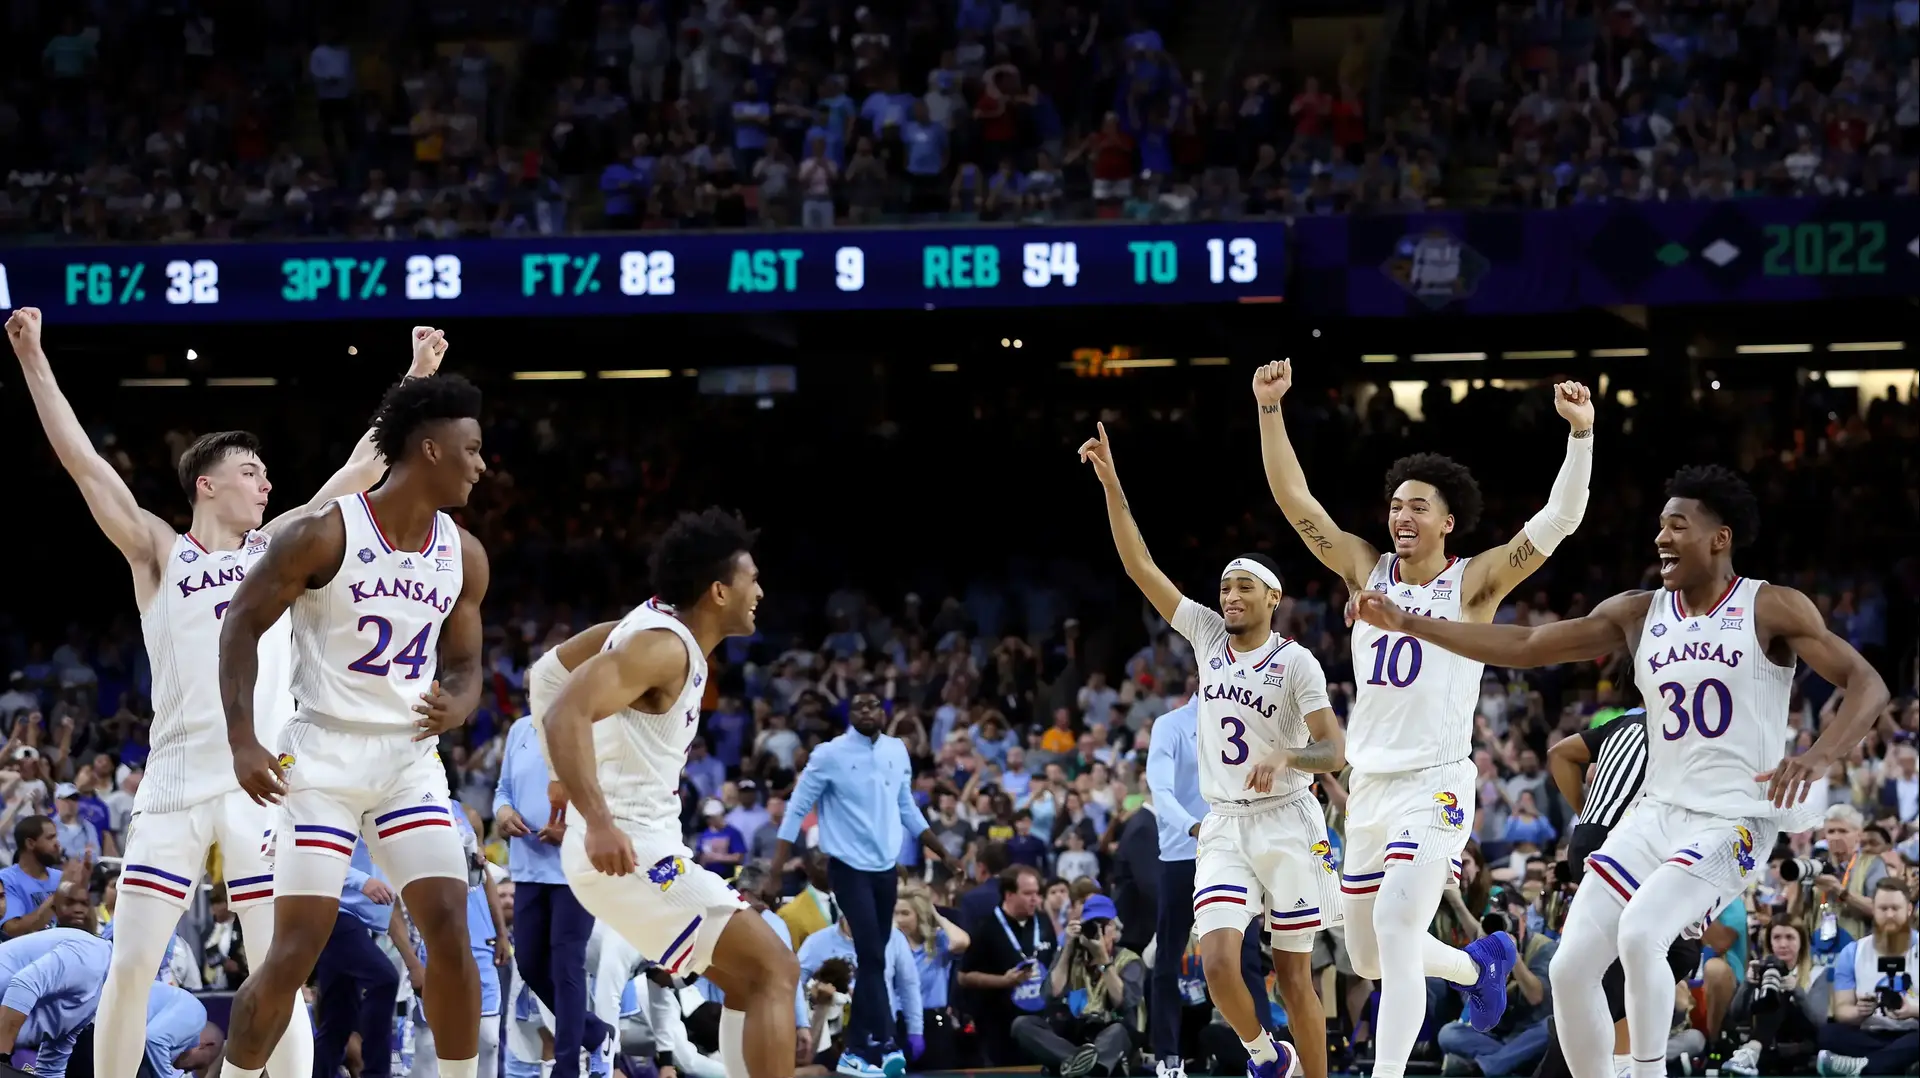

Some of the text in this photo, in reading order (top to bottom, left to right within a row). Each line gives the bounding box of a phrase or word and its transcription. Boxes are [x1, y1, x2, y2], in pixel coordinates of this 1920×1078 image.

[166, 260, 219, 304] 32
[406, 255, 462, 300] 23
[620, 251, 675, 295] 82
[728, 249, 803, 292] AST
[836, 246, 865, 291] 9
[923, 245, 1000, 288] REB
[1023, 242, 1080, 287] 54
[1128, 240, 1178, 284] TO
[1207, 238, 1258, 283] 13
[1763, 222, 1886, 275] 2022
[1296, 518, 1333, 558] FEAR
[1509, 539, 1535, 570] GOD
[176, 565, 246, 598] KANS
[349, 577, 453, 614] KANSAS
[348, 615, 432, 679] 24
[1366, 634, 1423, 688] 10
[1647, 641, 1744, 675] KANSAS
[1203, 682, 1278, 719] KANSAS
[1658, 677, 1734, 741] 30
[1220, 716, 1250, 766] 3
